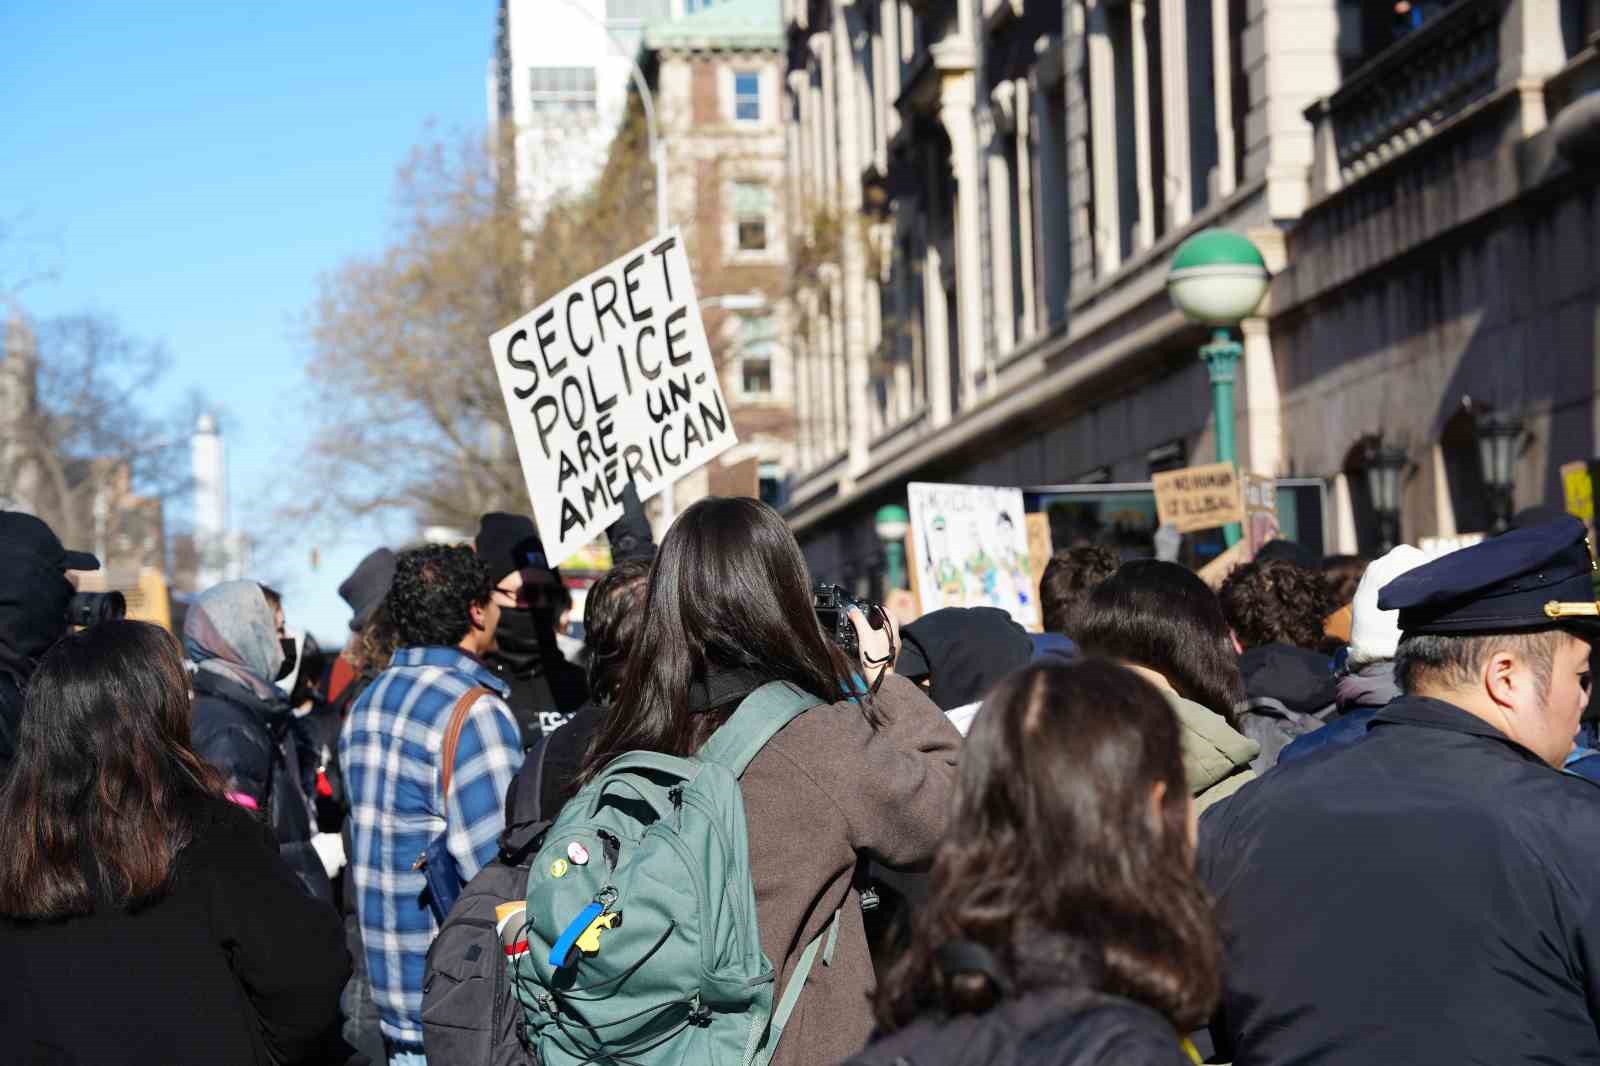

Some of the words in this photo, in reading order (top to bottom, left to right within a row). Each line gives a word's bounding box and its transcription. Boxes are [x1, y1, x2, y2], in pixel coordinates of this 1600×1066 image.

[507, 237, 676, 399] SECRET
[530, 305, 692, 459] POLICE
[558, 413, 619, 493] ARE
[646, 372, 706, 424] UN-
[559, 390, 726, 543] AMERICAN
